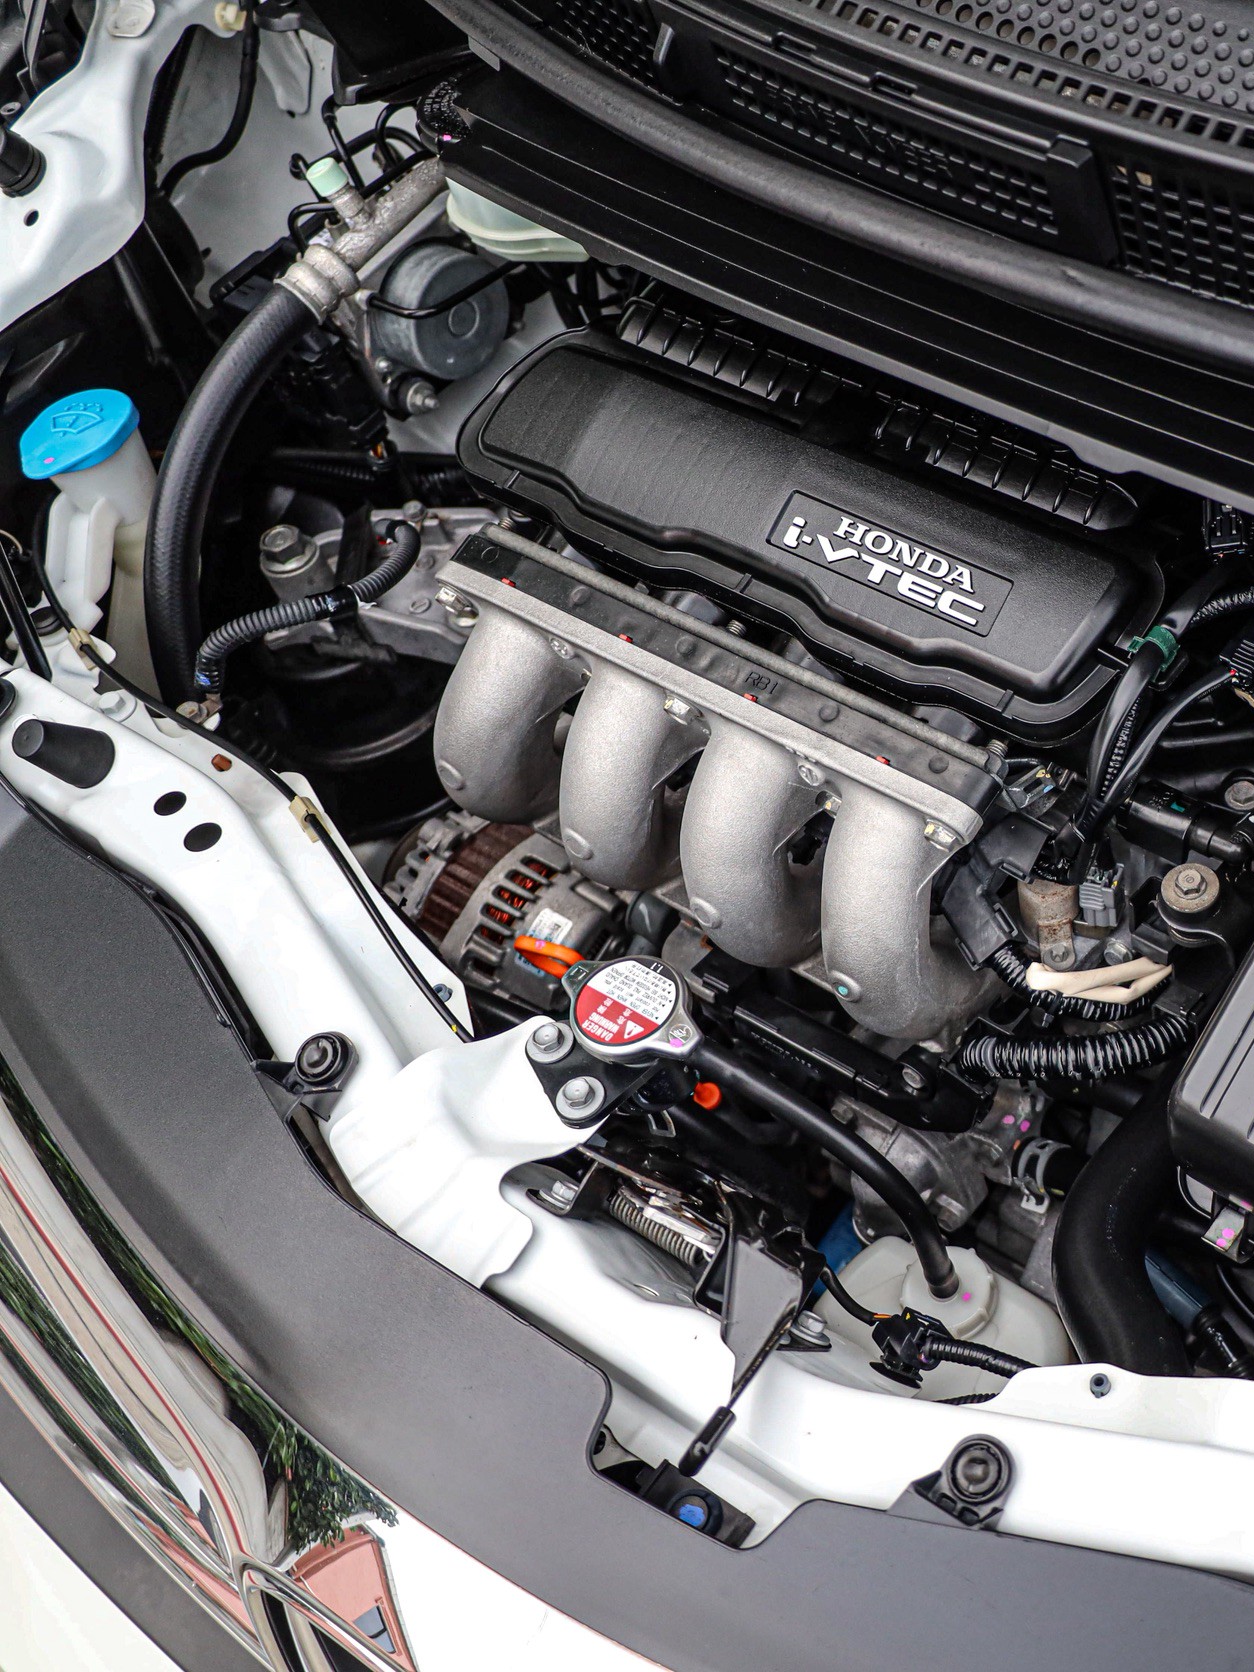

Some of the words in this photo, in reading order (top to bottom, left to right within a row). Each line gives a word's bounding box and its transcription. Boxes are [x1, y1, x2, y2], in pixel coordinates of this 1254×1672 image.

[783, 516, 986, 626] i-VTEC
[831, 514, 975, 594] HONDA
[580, 1017, 613, 1042] DANGER
[588, 1010, 620, 1033] WARNUNG
